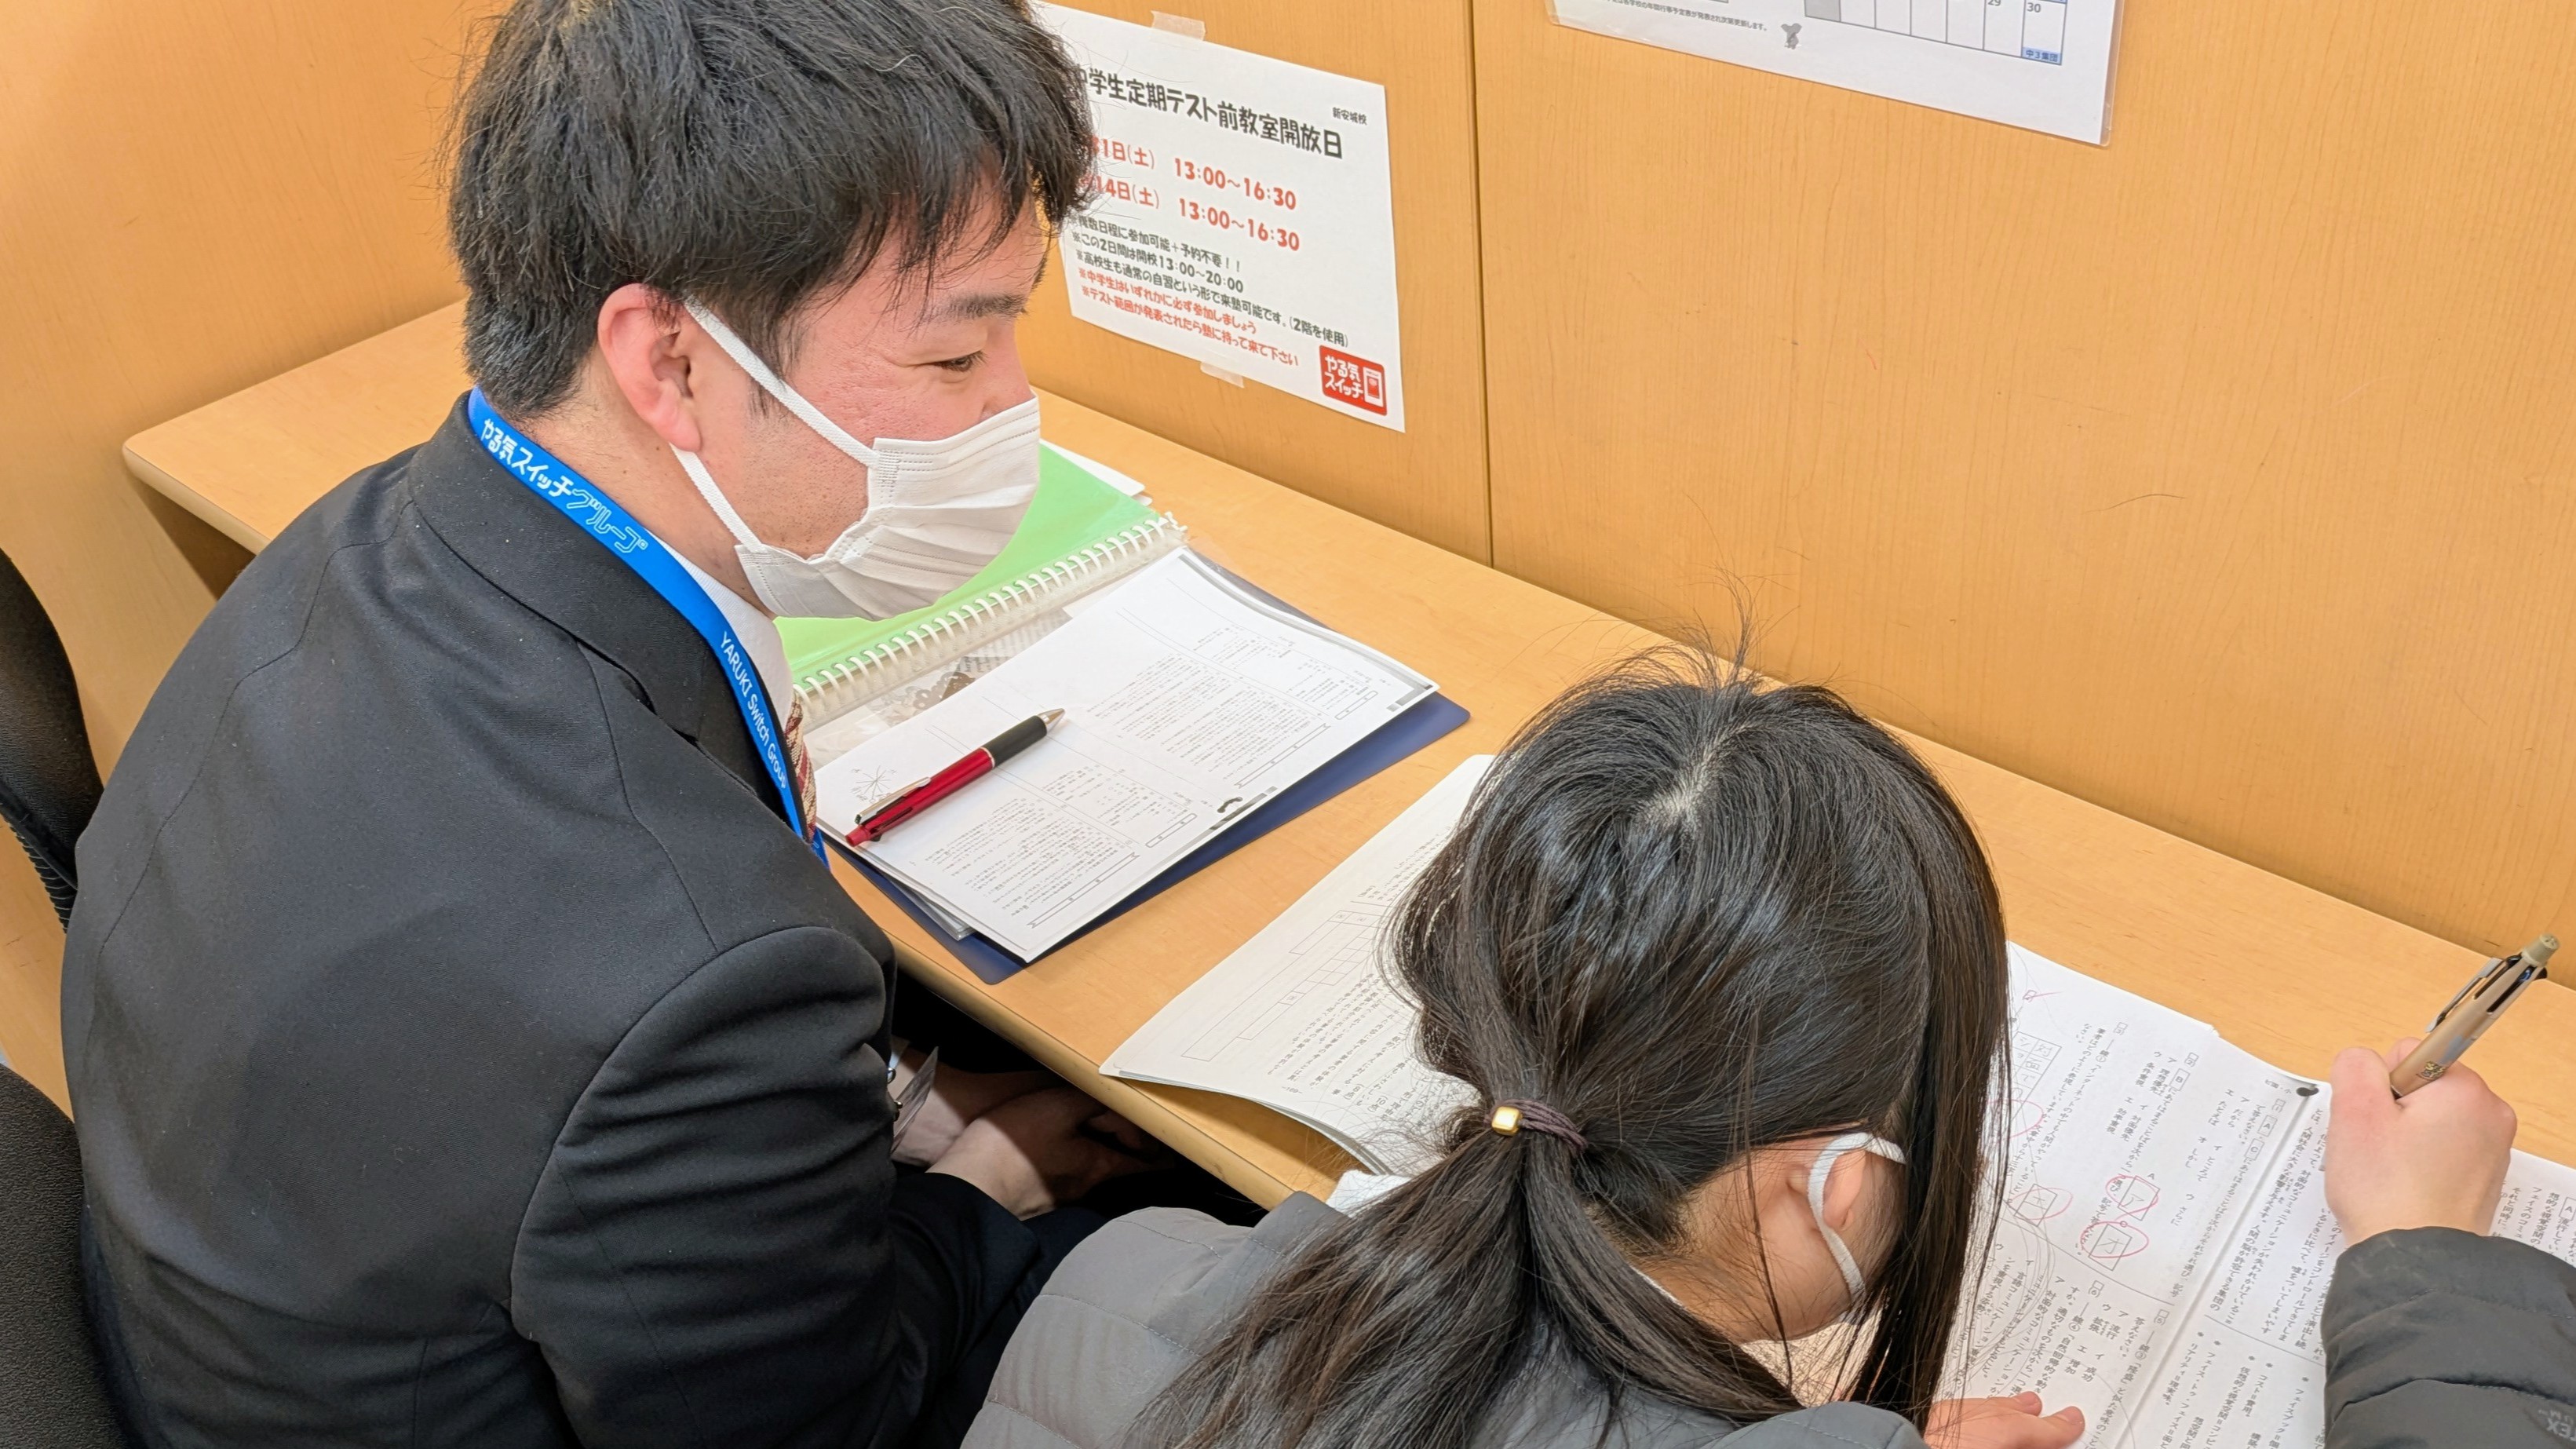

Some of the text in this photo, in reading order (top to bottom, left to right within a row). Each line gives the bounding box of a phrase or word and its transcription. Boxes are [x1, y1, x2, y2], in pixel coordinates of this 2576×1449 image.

[2027, 2, 2041, 13] 30
[1332, 107, 1367, 126] 新安城校
[1078, 267, 1257, 335] ※中学生はいずれかに必ず参加しましょう
[1082, 285, 1299, 367] ※テスト範囲が発表されたら塾に持って来て下さい
[1325, 355, 1361, 382] やる気
[1324, 371, 1363, 399] スイッチ
[480, 418, 648, 553] やる気スイッチグループ
[721, 631, 786, 788] YARUKI Switch Group
[2279, 1221, 2341, 1341] のイメージをコントロールできてしま
[2089, 1316, 2104, 1332] 拡張
[2105, 1323, 2121, 1340] 流行
[2119, 1316, 2146, 1357] 答えなさい。
[2008, 1286, 2080, 1397] すか。適切なものを次から一つ選
[2064, 1358, 2080, 1374] 増加
[2081, 1366, 2097, 1382] 成功
